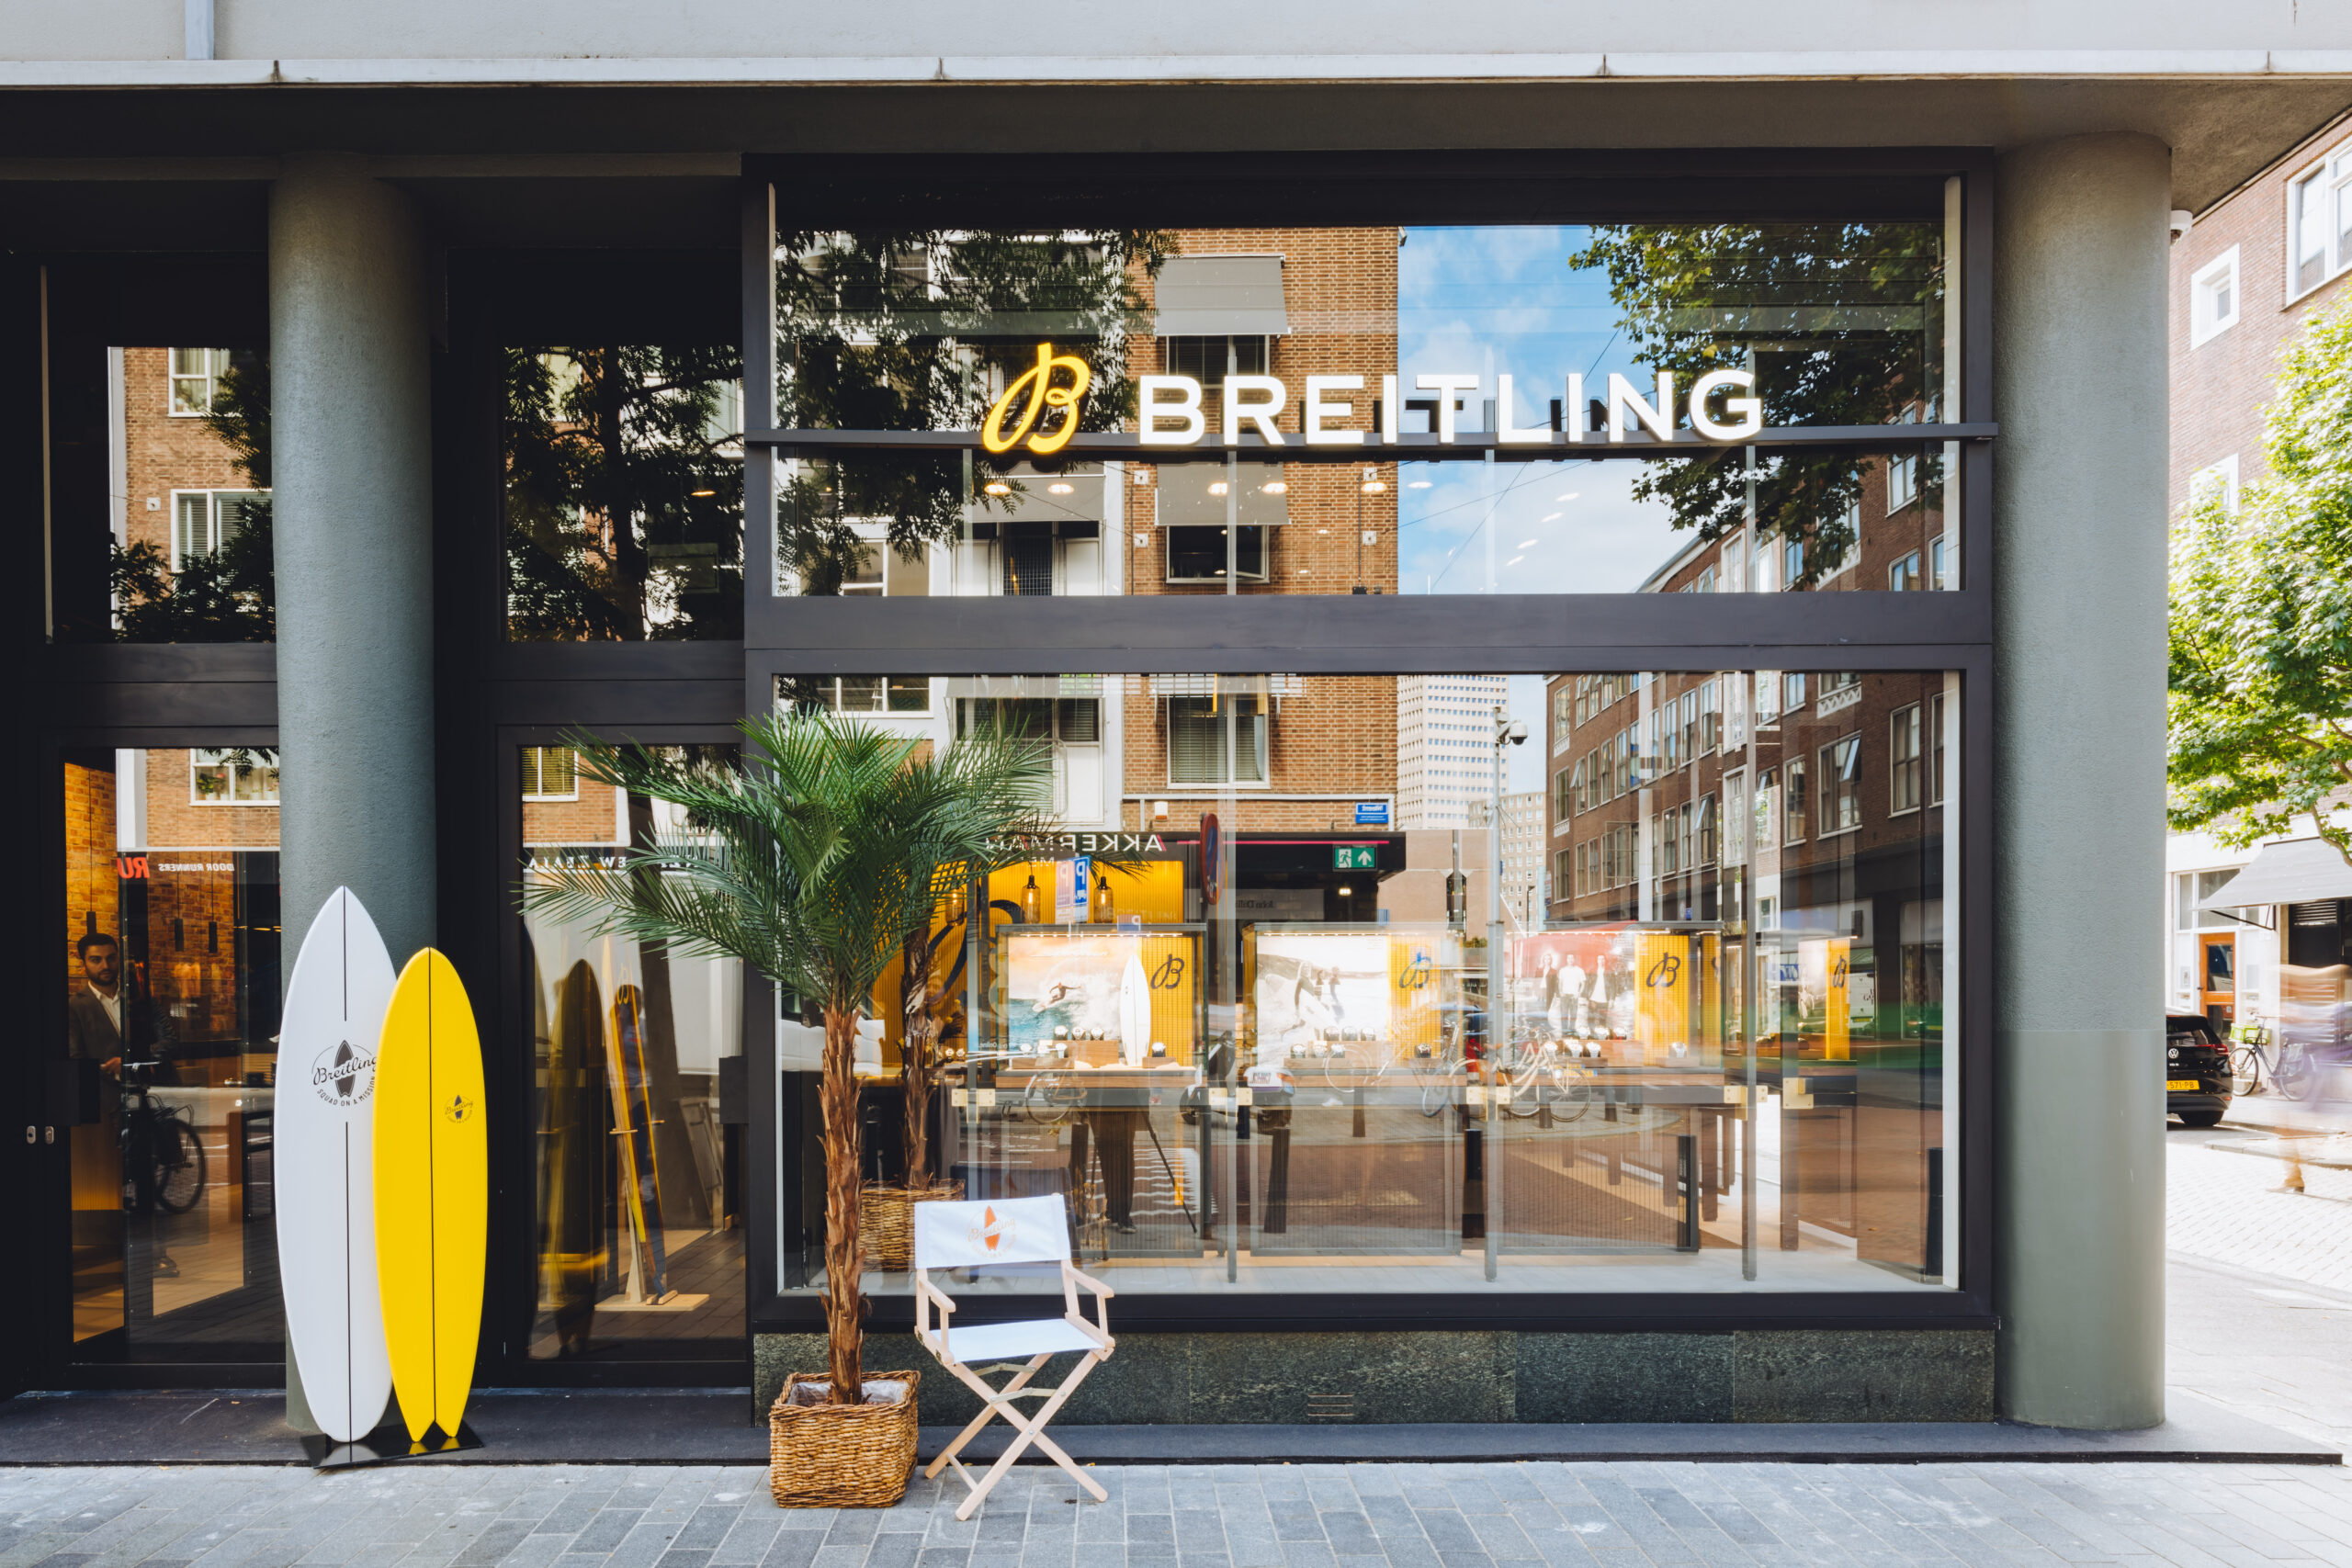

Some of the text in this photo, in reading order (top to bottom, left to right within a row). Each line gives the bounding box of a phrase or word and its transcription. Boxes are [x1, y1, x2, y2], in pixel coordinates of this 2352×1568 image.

[1139, 369, 1761, 446] BREITLING
[317, 1089, 338, 1106] SQUAD
[358, 1076, 375, 1102] MISSION
